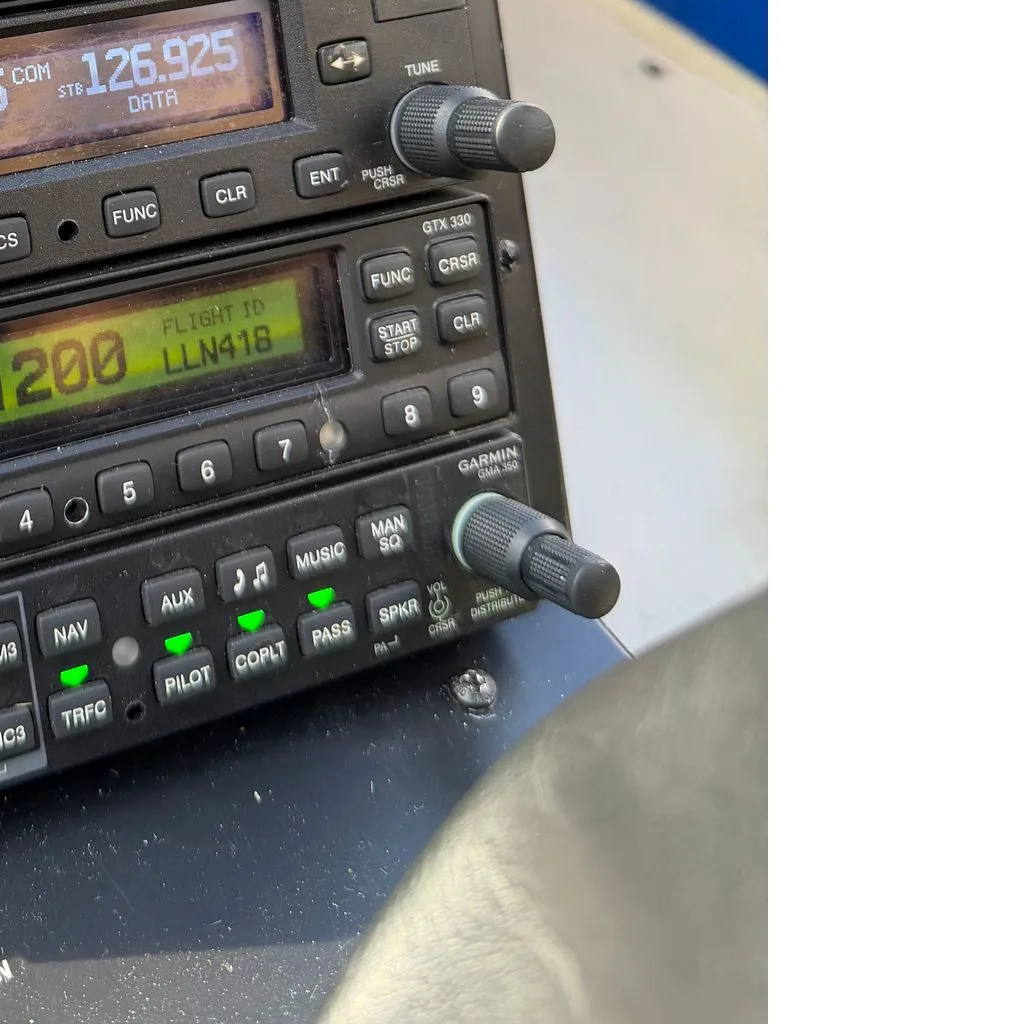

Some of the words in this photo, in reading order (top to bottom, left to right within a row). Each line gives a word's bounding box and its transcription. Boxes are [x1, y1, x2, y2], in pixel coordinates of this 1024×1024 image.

[11, 62, 53, 86] COM
[80, 29, 241, 97] 126.925
[404, 59, 440, 77] TUNE
[57, 83, 83, 99] STB
[128, 88, 179, 114] DATA
[309, 166, 340, 186] ENT
[361, 165, 392, 181] PUSH
[373, 173, 405, 190] CRSR
[215, 186, 248, 204] CLR
[112, 202, 158, 225] FUNC
[422, 215, 447, 234] GTX
[448, 212, 472, 228] 330
[438, 252, 478, 274] CRSR
[371, 267, 413, 289] FUNC
[162, 307, 233, 336] FLIGHT
[378, 318, 417, 339] START
[162, 325, 273, 375] LLN418
[384, 337, 419, 358] STOP
[458, 445, 519, 474] GARMIN
[477, 465, 500, 481] GMA
[501, 460, 518, 475] 350
[371, 514, 406, 538] MAN
[296, 541, 346, 571] MUSIC
[161, 587, 195, 611] AUX
[426, 580, 446, 595] VOL
[378, 597, 421, 625] SPKR
[53, 621, 90, 646] NAV
[312, 618, 354, 649] PASS
[235, 640, 287, 671] COPLT
[164, 663, 213, 698] PILOT
[61, 699, 108, 728] TRFC
